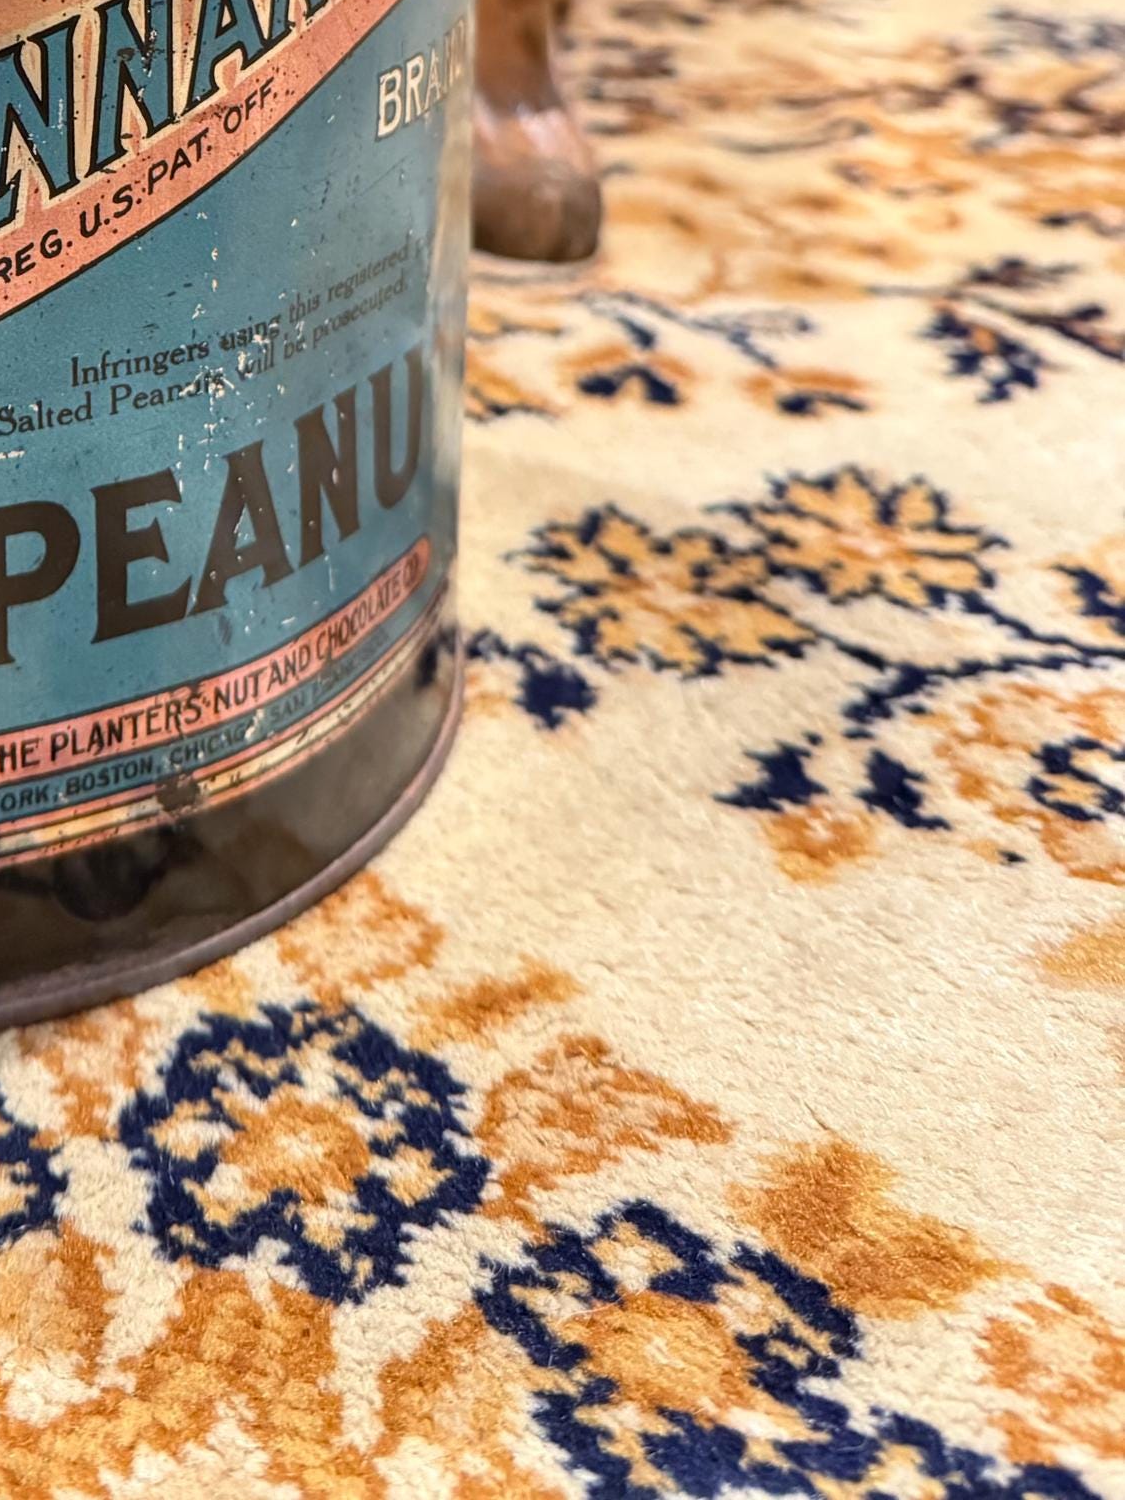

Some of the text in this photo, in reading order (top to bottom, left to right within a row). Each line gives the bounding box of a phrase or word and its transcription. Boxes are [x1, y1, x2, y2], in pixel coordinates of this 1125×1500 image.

[70, 340, 210, 388] Infringers
[220, 314, 281, 350] using
[289, 289, 320, 323] this
[328, 234, 410, 302] registered
[214, 666, 268, 714] NUT
[267, 645, 311, 693] AND
[316, 570, 402, 661] CHOCOLATE
